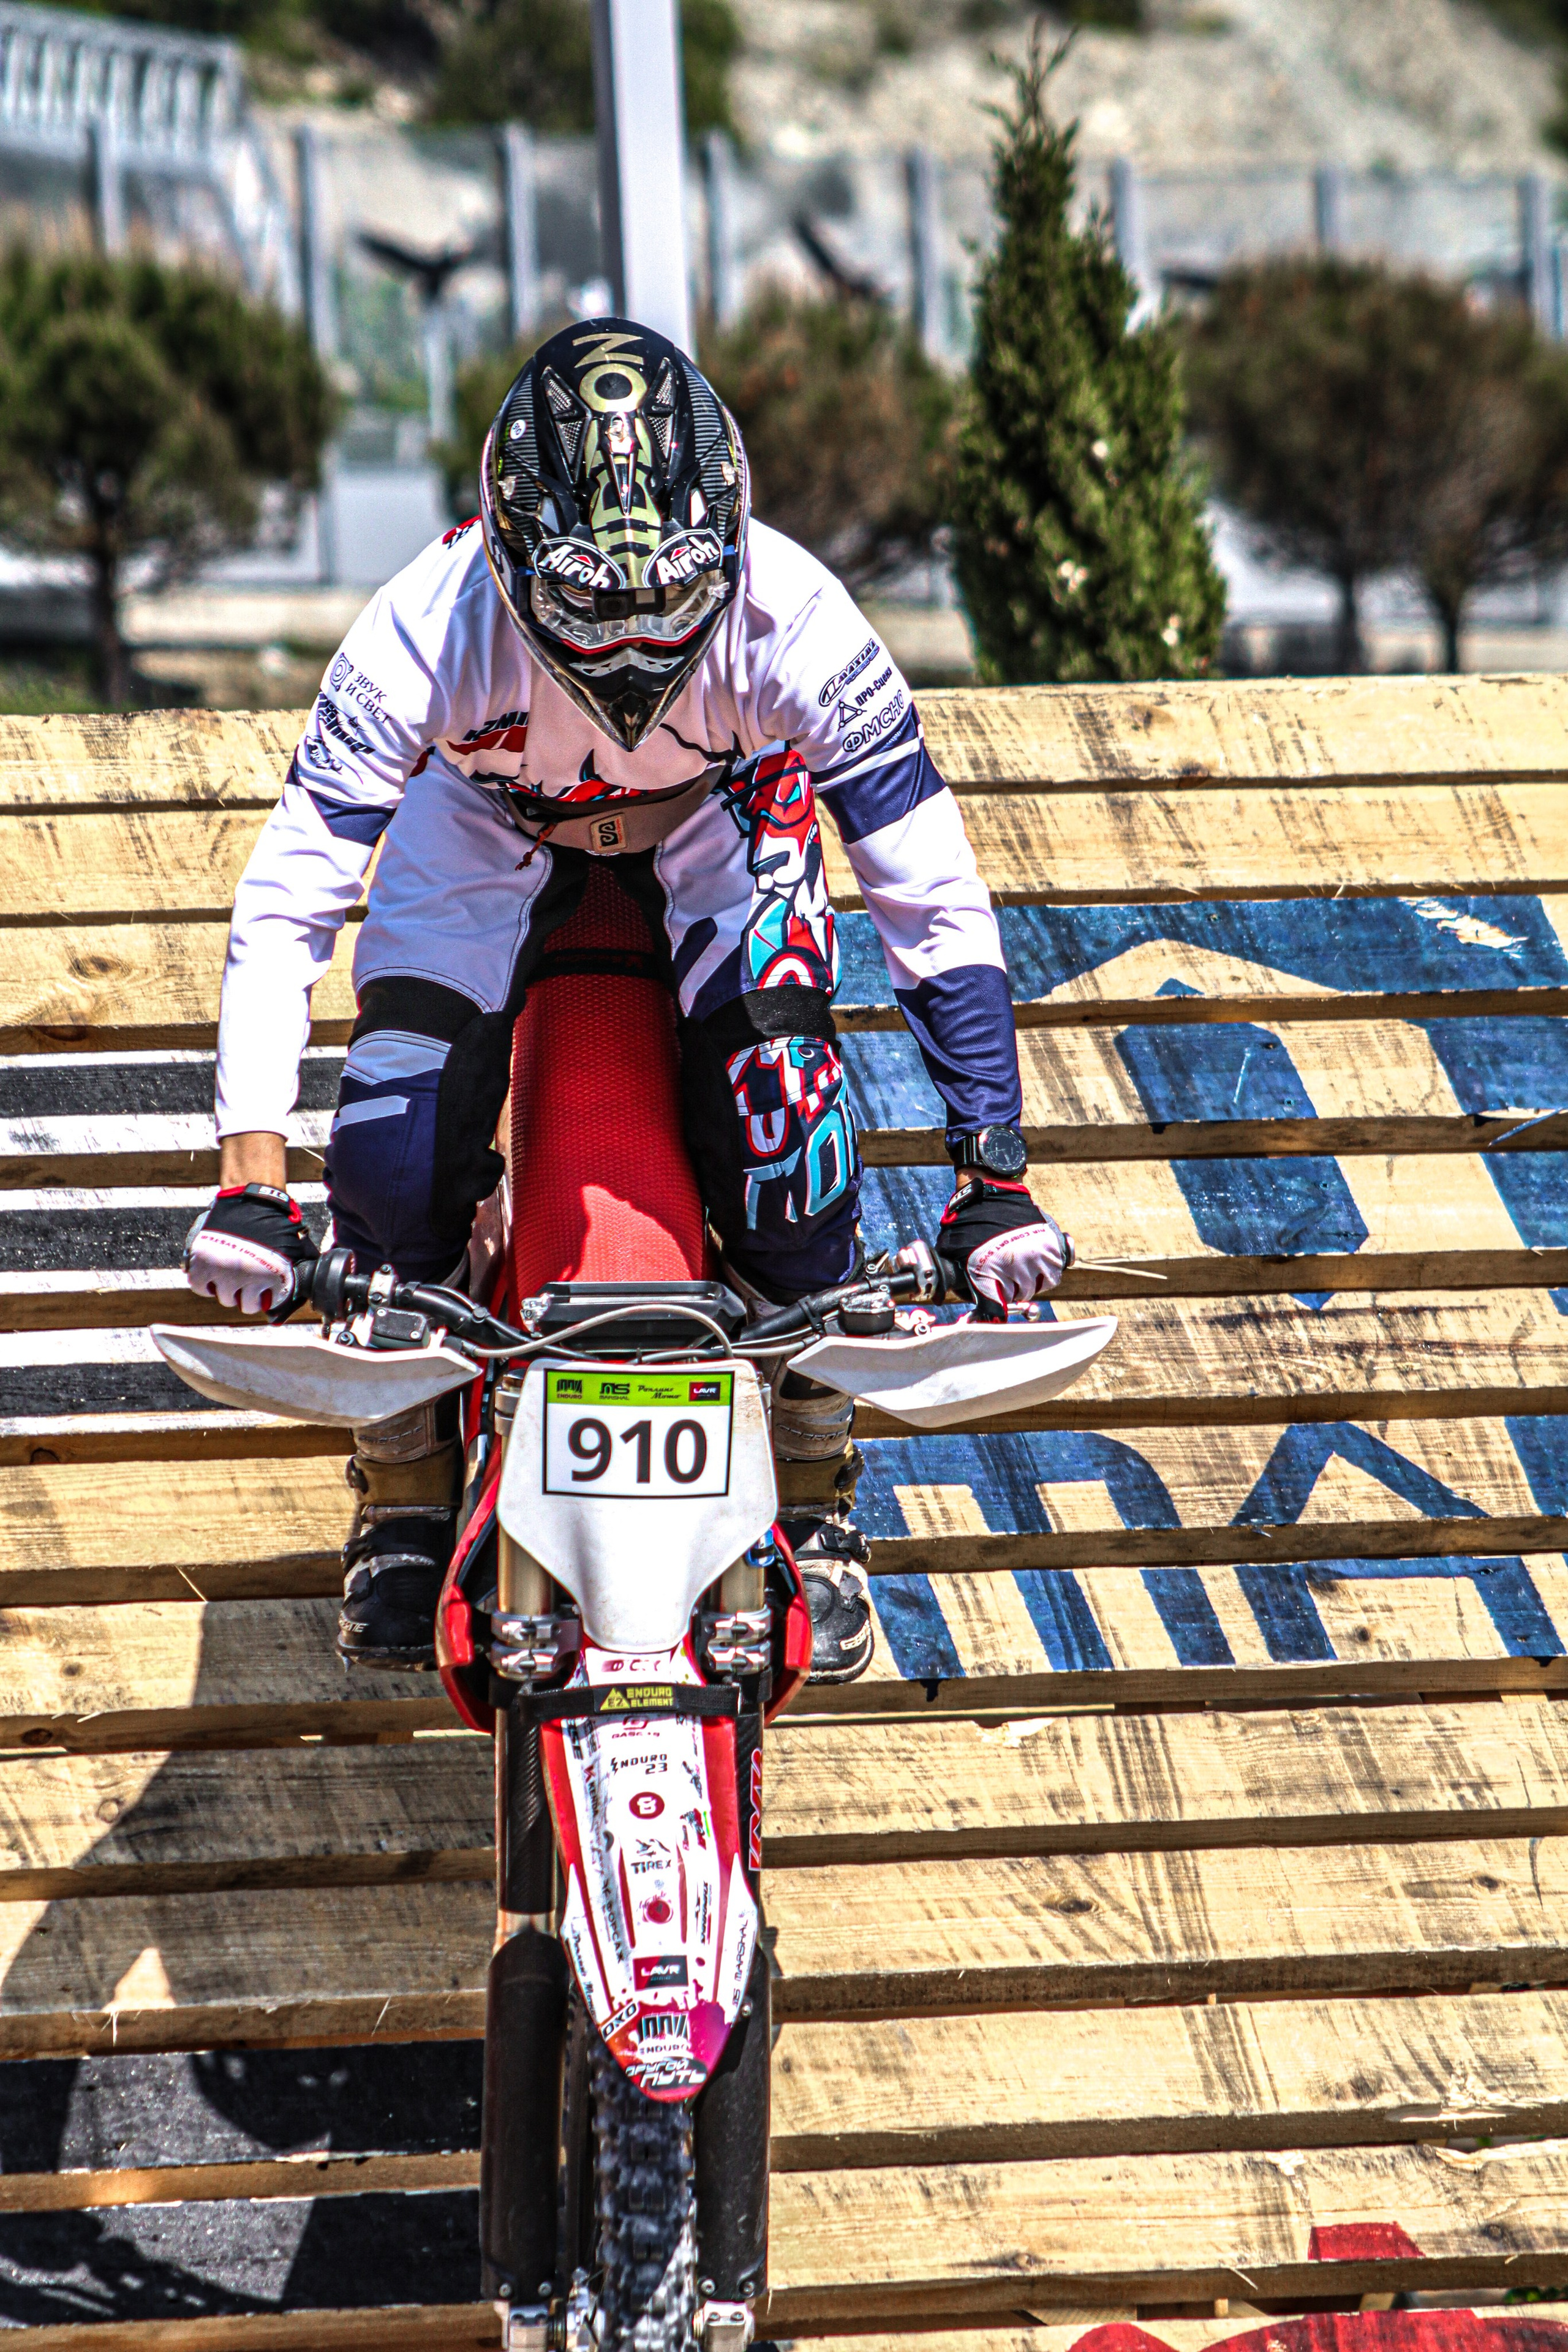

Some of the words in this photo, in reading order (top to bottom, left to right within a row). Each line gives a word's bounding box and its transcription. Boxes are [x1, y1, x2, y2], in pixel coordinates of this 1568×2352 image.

[537, 544, 611, 588] Airoh
[656, 536, 720, 585] Airoh
[344, 682, 357, 696] И
[356, 693, 393, 724] СВЕТ
[353, 671, 387, 704] ЗВУК
[568, 1417, 708, 1484] 910
[626, 1686, 673, 1697] ENDURO
[630, 1698, 673, 1708] ELEMENT
[645, 1763, 668, 1775] 23
[734, 1918, 748, 1983] MARSHAL
[640, 1964, 680, 1977] LAVR
[601, 2002, 638, 2040] OXO
[640, 2068, 707, 2088] ПУТЬ
